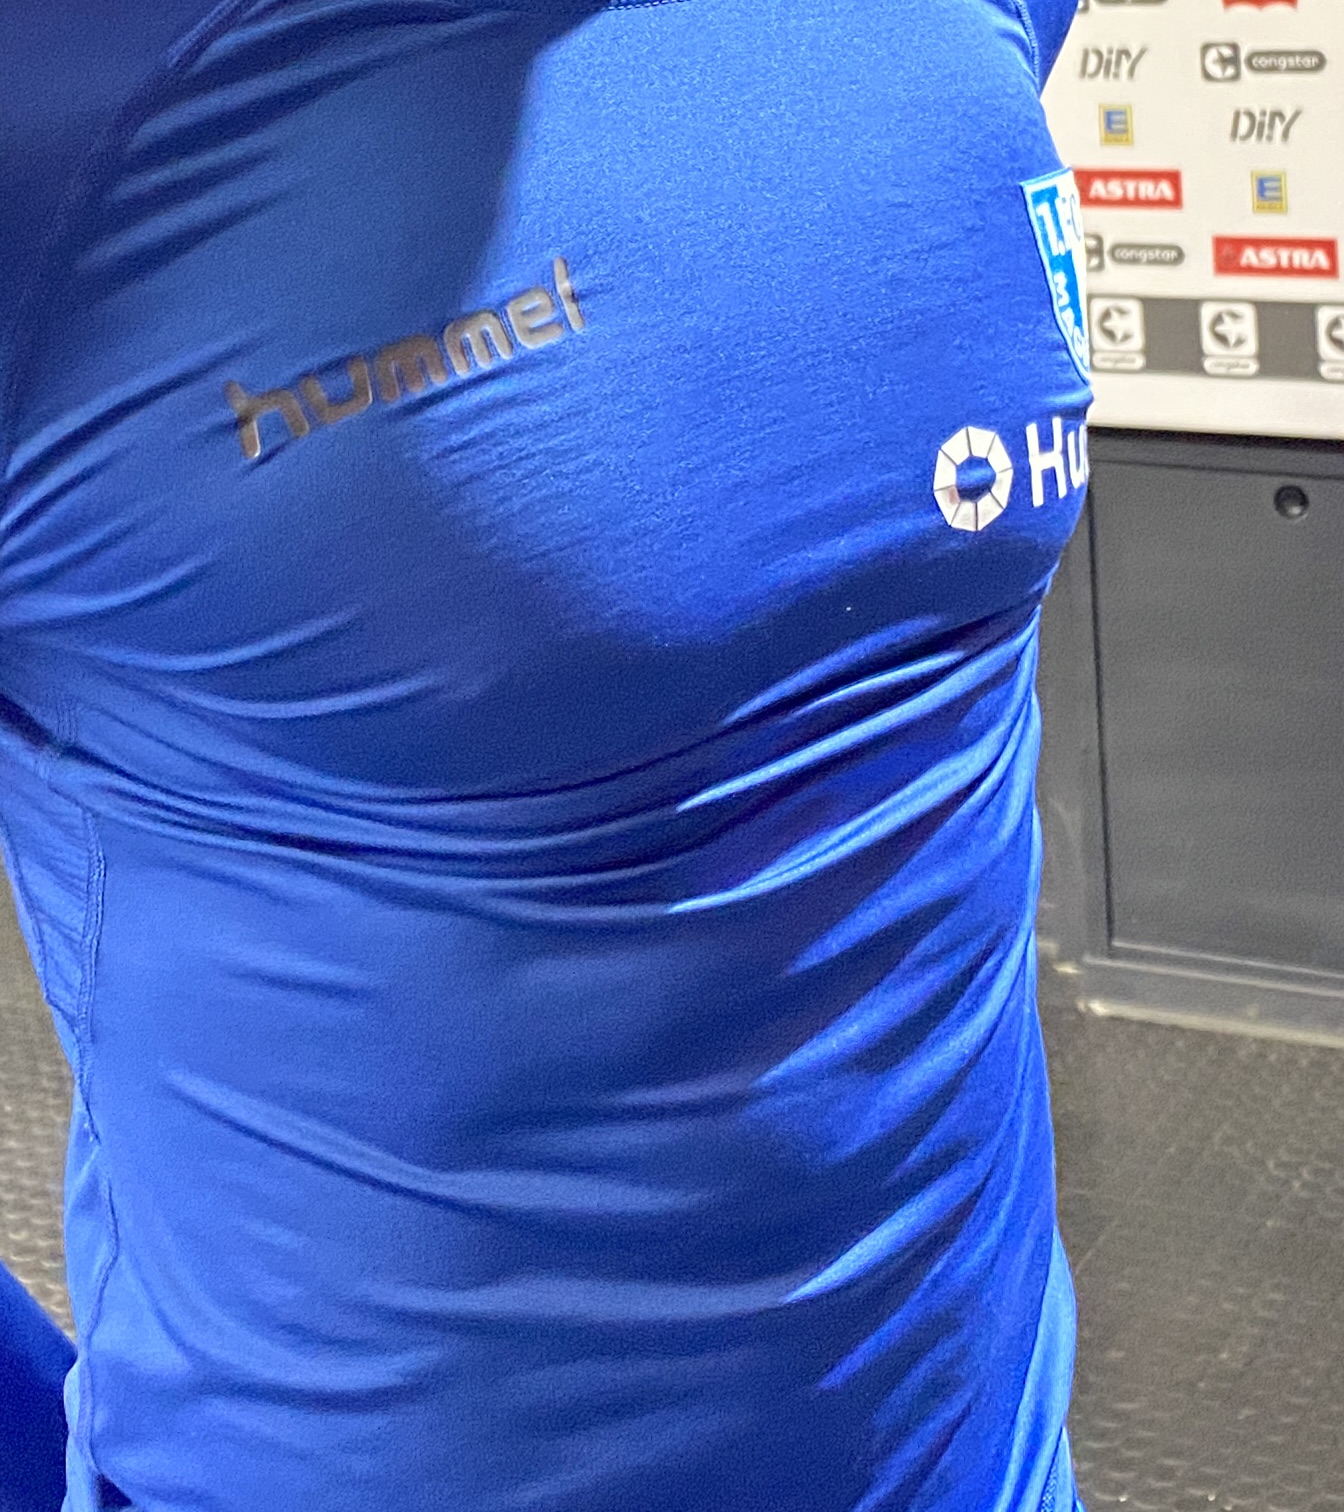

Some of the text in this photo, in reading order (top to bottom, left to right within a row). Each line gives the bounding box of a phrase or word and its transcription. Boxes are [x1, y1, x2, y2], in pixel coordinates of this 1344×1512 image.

[1091, 181, 1172, 198] ASTRA
[1241, 248, 1328, 267] ASTRA
[224, 255, 585, 458] hummel
